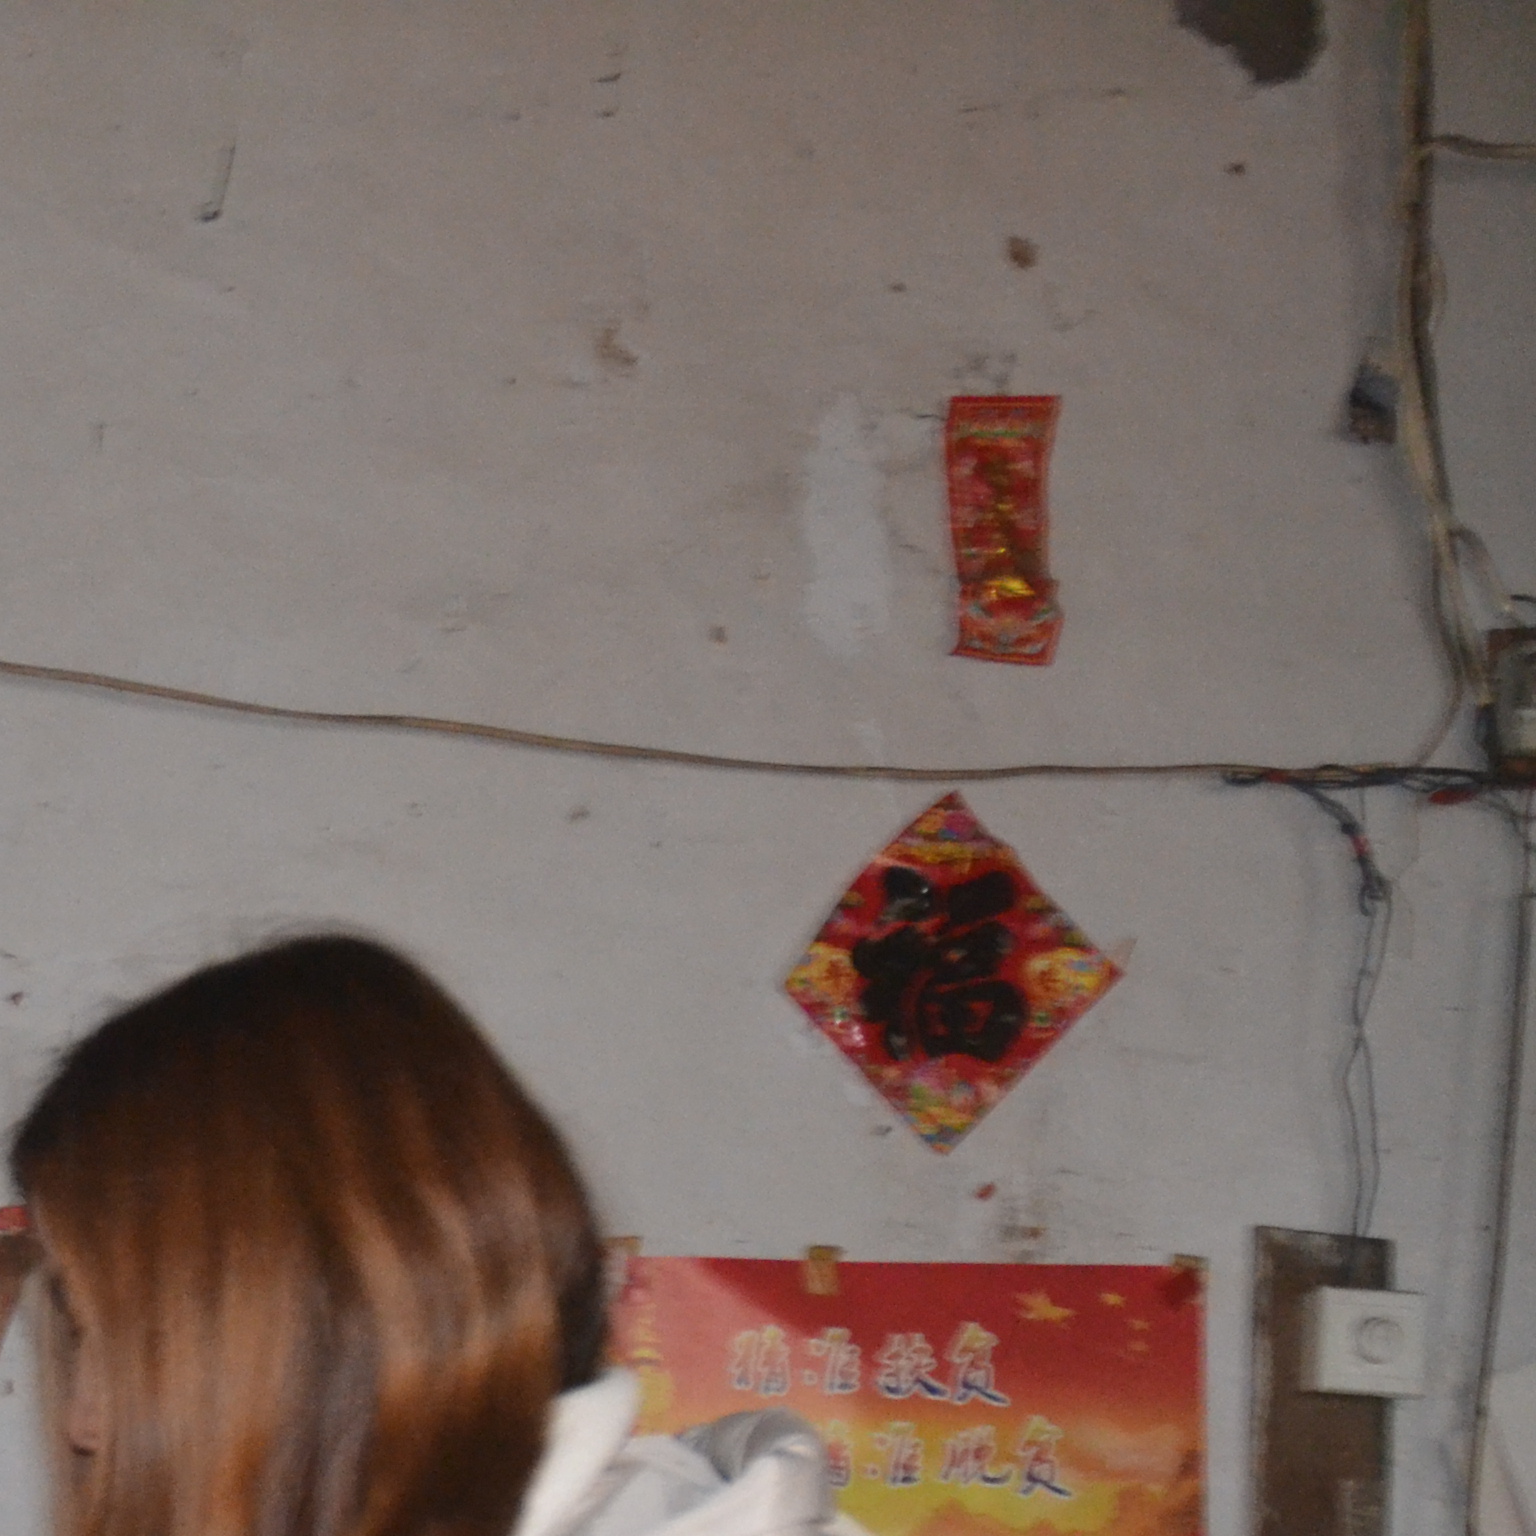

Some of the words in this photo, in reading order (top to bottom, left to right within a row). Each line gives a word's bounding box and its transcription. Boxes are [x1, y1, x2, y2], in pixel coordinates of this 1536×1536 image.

[851, 866, 1031, 1063] 福
[730, 1324, 1011, 1407] 精准扶贫
